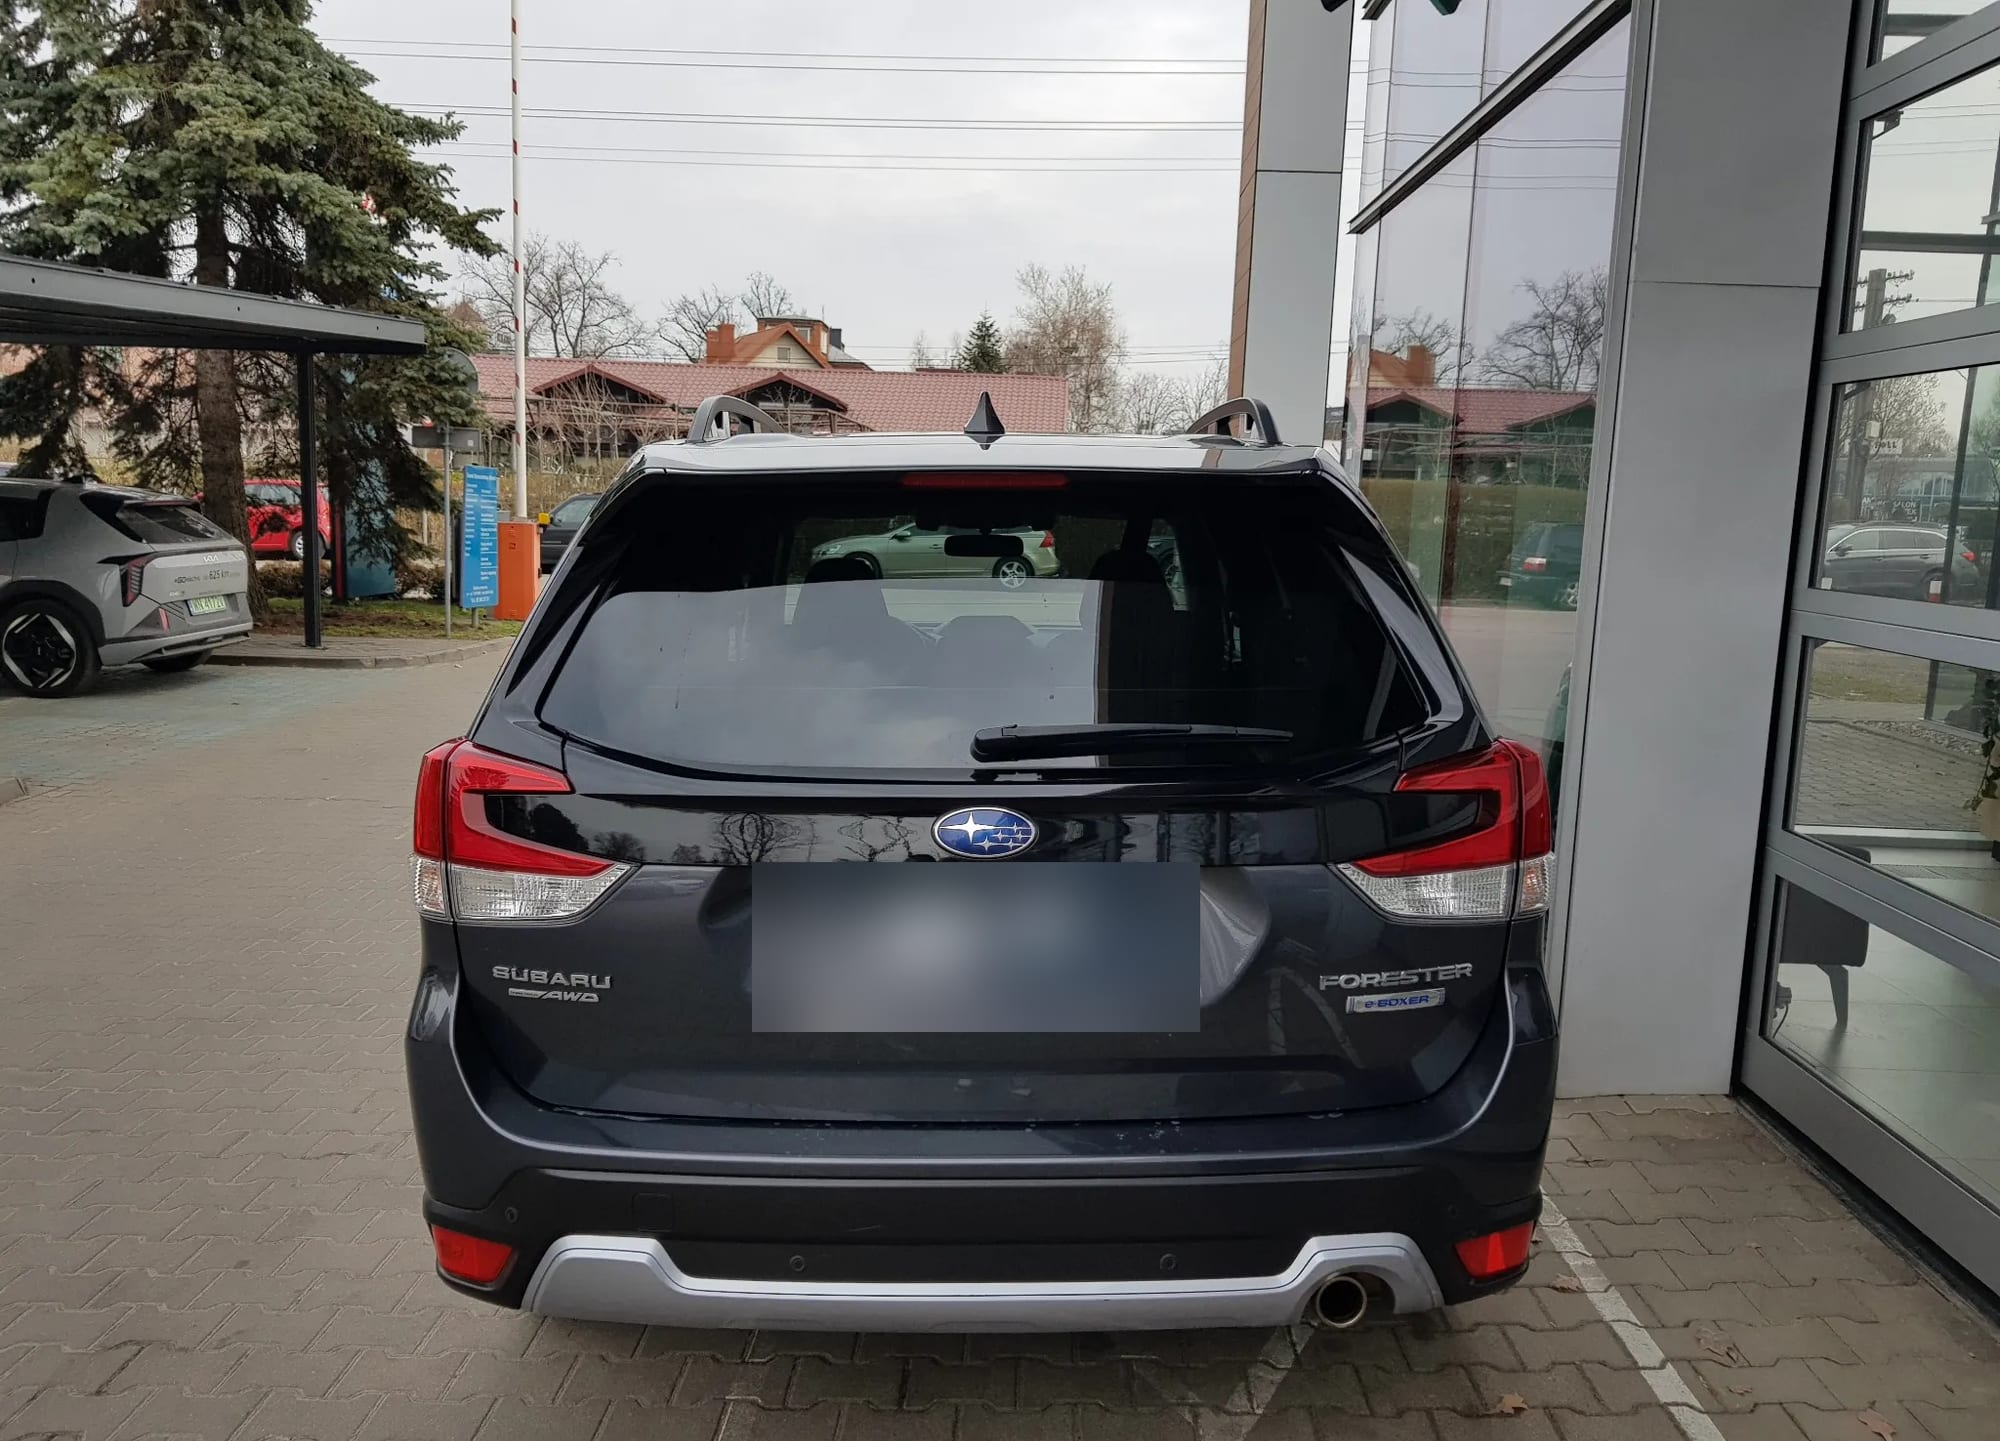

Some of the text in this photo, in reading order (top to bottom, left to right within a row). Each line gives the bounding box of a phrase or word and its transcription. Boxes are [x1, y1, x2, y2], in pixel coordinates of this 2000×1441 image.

[492, 966, 611, 989] SUBARU
[1319, 963, 1473, 990] FORESTER
[542, 991, 599, 1002] AWD
[1364, 995, 1429, 1008] e-BOXER
